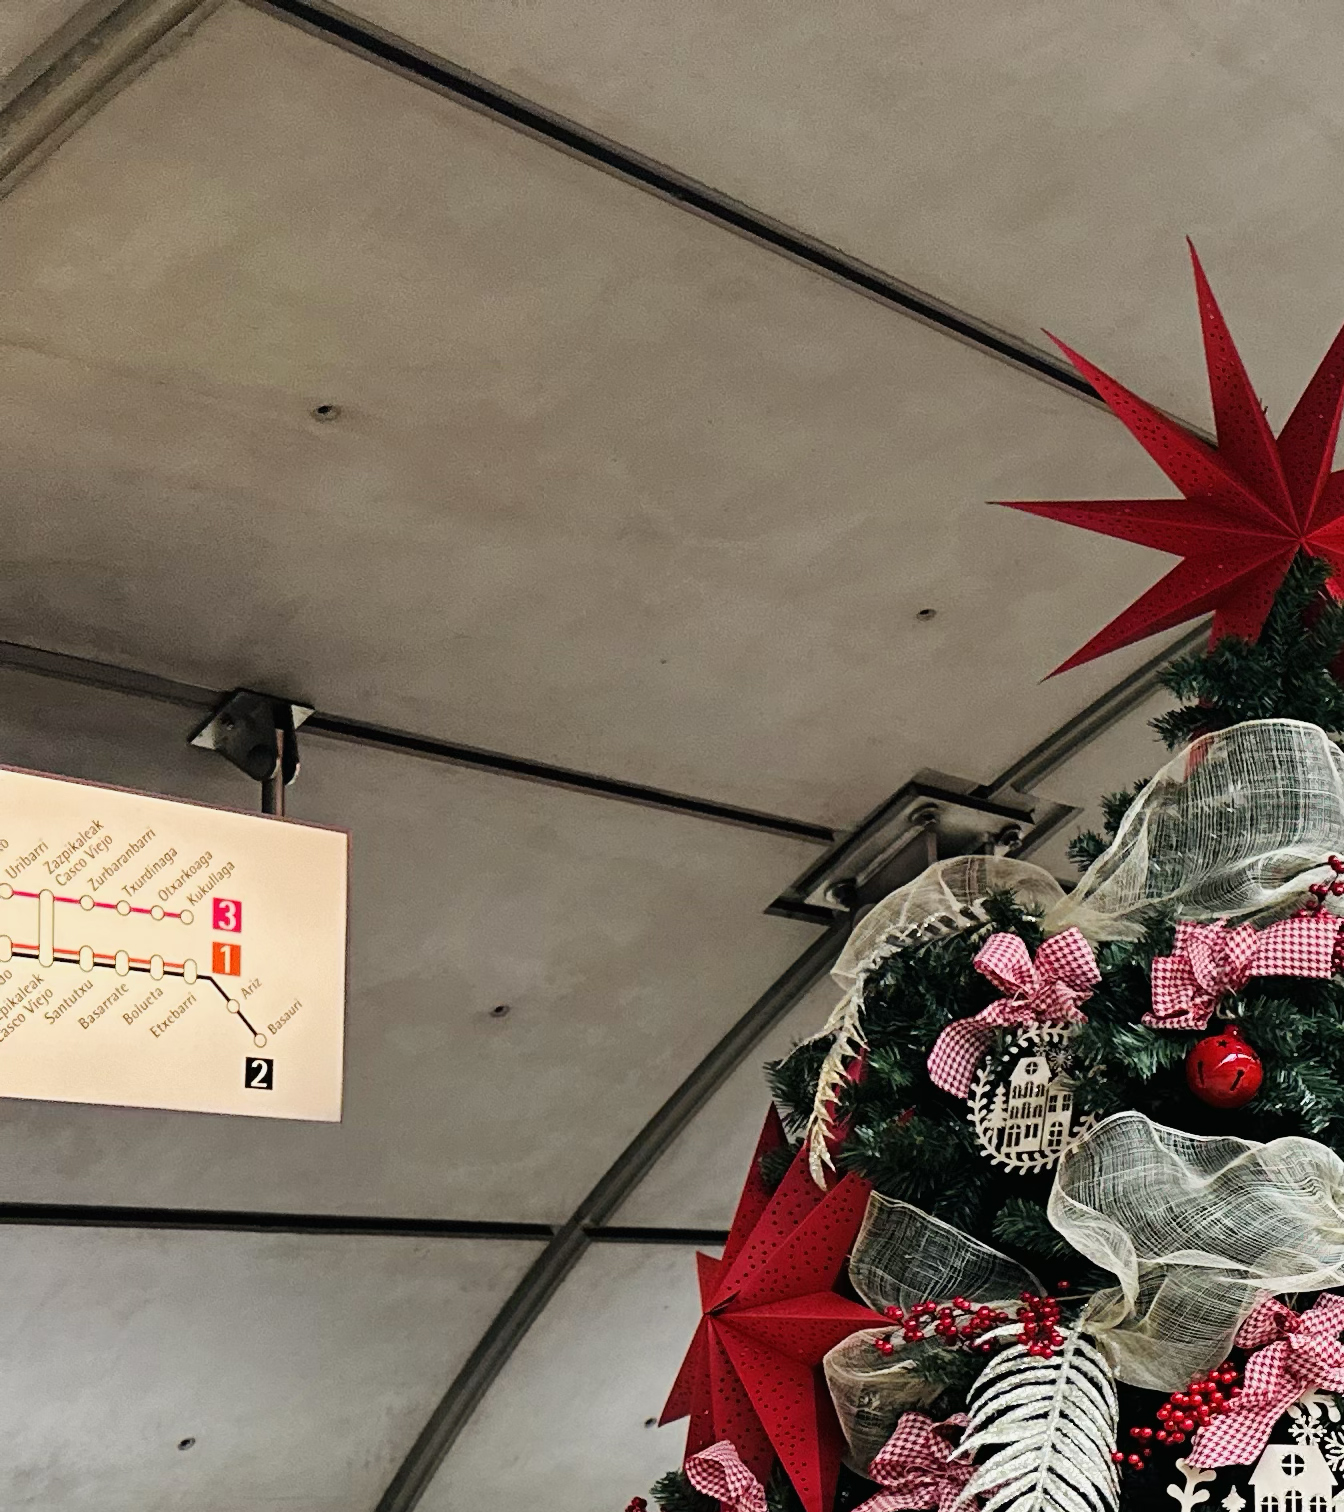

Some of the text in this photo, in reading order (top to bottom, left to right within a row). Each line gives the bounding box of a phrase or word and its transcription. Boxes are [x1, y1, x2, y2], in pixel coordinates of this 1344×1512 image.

[5, 838, 49, 880] Uribarri
[42, 820, 105, 875] Zazpikaleak
[55, 832, 113, 887] Casco Viejo
[87, 827, 156, 892] Zurbaranbarri
[121, 847, 178, 898] Txurdinaga
[158, 850, 213, 902] Otxarkoaga
[186, 860, 236, 907] Kukullaga
[218, 900, 237, 931] 3
[219, 945, 231, 974] 1
[25, 986, 54, 1015] Viejo
[44, 978, 94, 1026] Santutxu
[77, 981, 130, 1031] Basarrate
[122, 986, 164, 1027] Bolueta
[240, 977, 263, 1000] Ariz
[149, 992, 197, 1039] Etxebarri
[267, 998, 304, 1036] Basauri
[250, 1059, 269, 1089] 2
